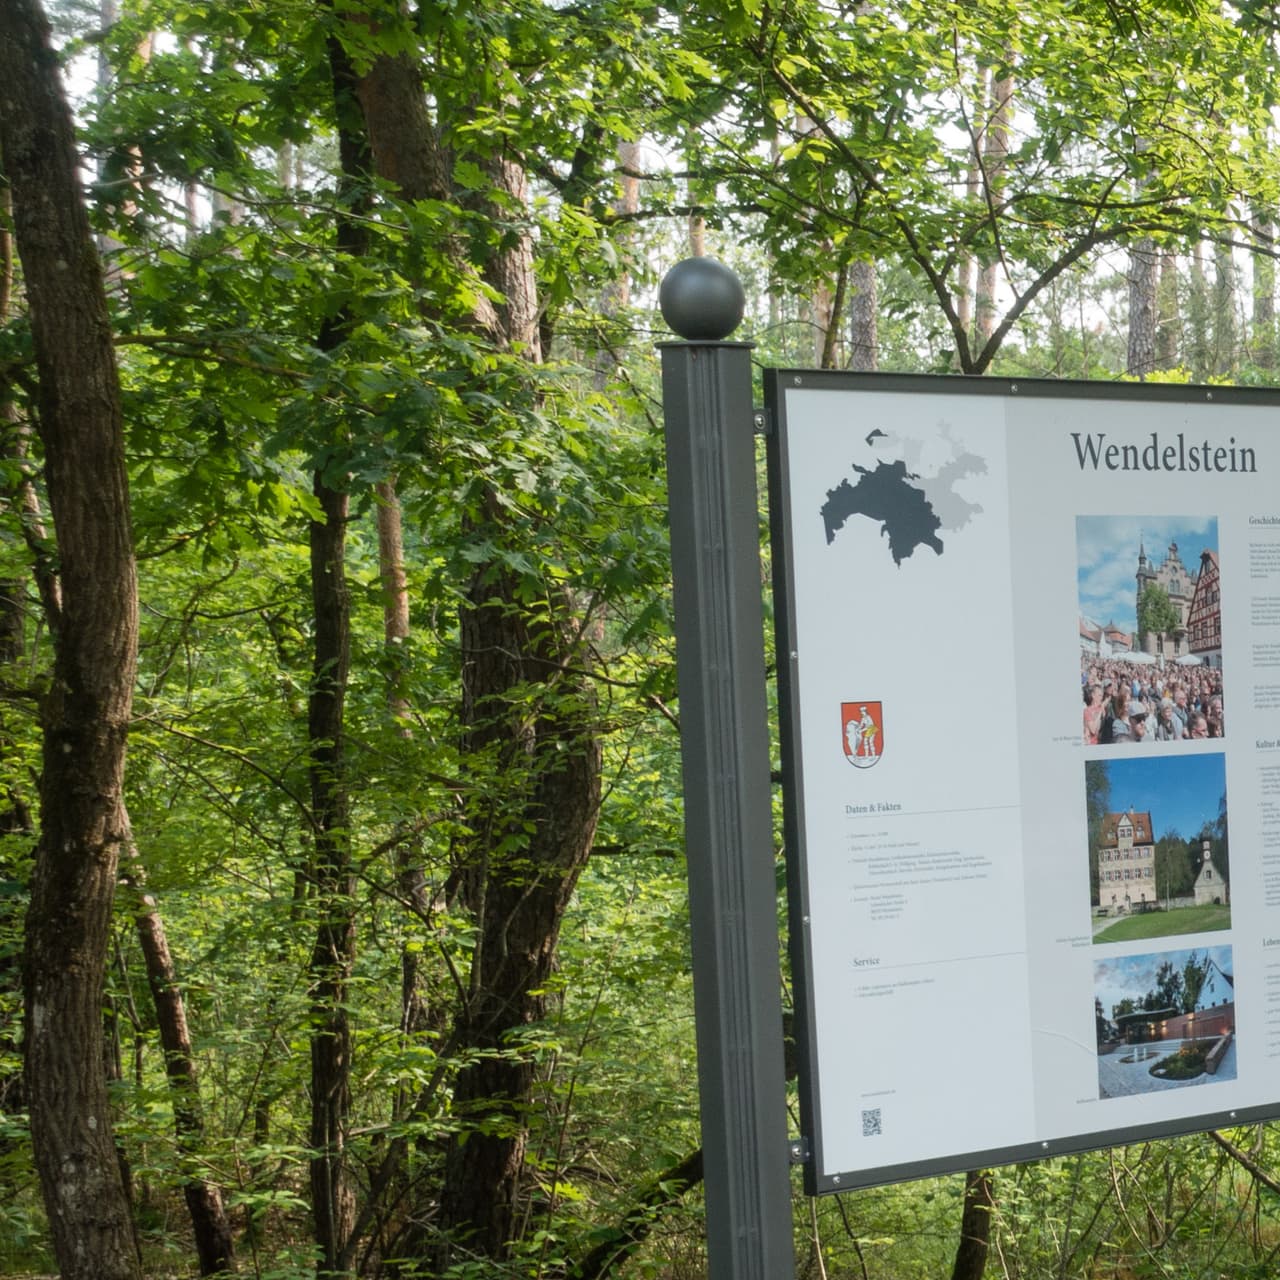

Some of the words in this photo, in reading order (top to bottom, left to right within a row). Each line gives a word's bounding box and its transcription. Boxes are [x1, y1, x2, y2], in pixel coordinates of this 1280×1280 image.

[1071, 432, 1258, 474] Wendelstein
[1255, 738, 1275, 749] Kultur
[845, 804, 868, 814] Daten
[877, 801, 902, 812] Fakten
[1263, 937, 1280, 947] Leben
[853, 957, 881, 967] Service
